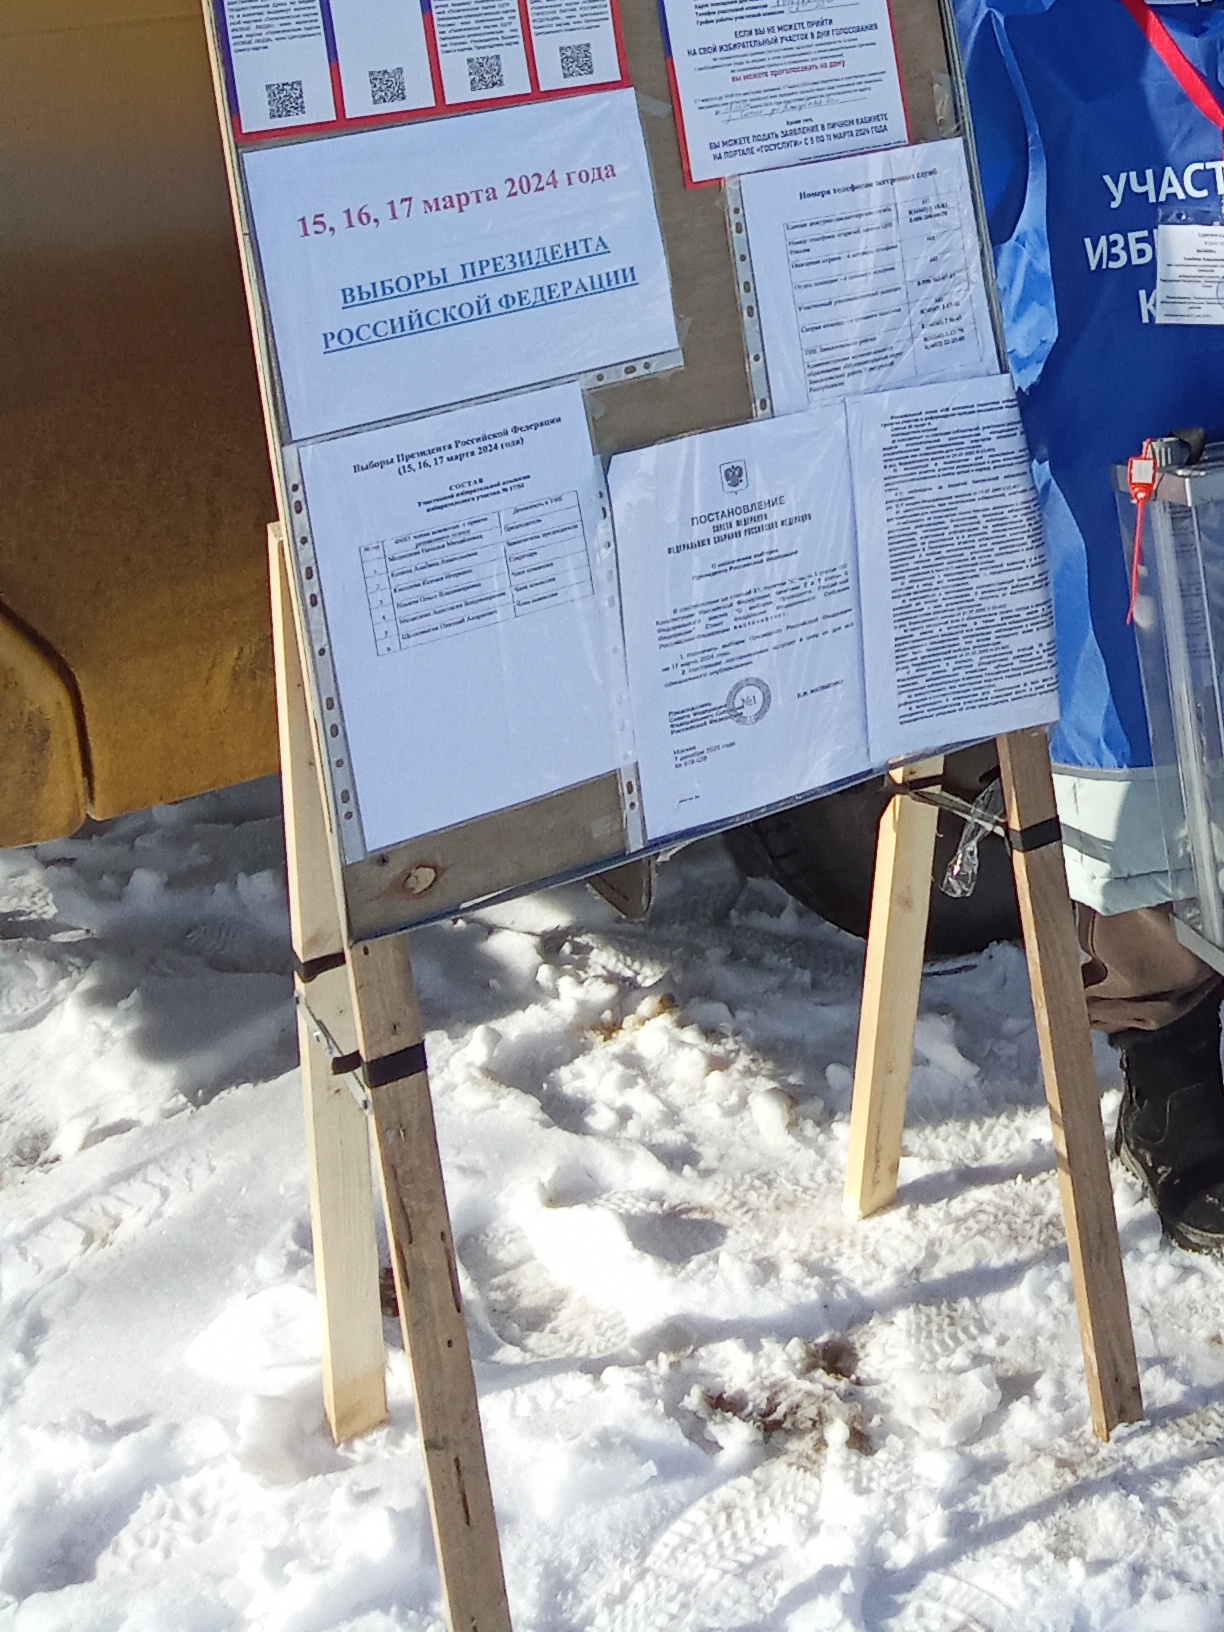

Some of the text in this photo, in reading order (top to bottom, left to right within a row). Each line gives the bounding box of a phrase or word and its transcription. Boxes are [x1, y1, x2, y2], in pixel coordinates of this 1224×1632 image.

[755, 26, 766, 36] ВЫ
[777, 22, 806, 33] МОЖЕТЕ
[297, 163, 617, 238] 15, 16, 17 марта 2024 года
[799, 187, 831, 201] Номера
[341, 235, 610, 306] ВЫБОРЫ ПРЕЗИДЕНТА
[323, 266, 638, 350] РОССИЙСКОЙ ФЕДЕРАЦИИ
[353, 416, 562, 474] Выборы Президента Российской Федерации
[398, 437, 525, 476] (15, 16, 17 марта 2024 года)
[691, 496, 786, 526] ПОСТАНОВЛЕНИЕ
